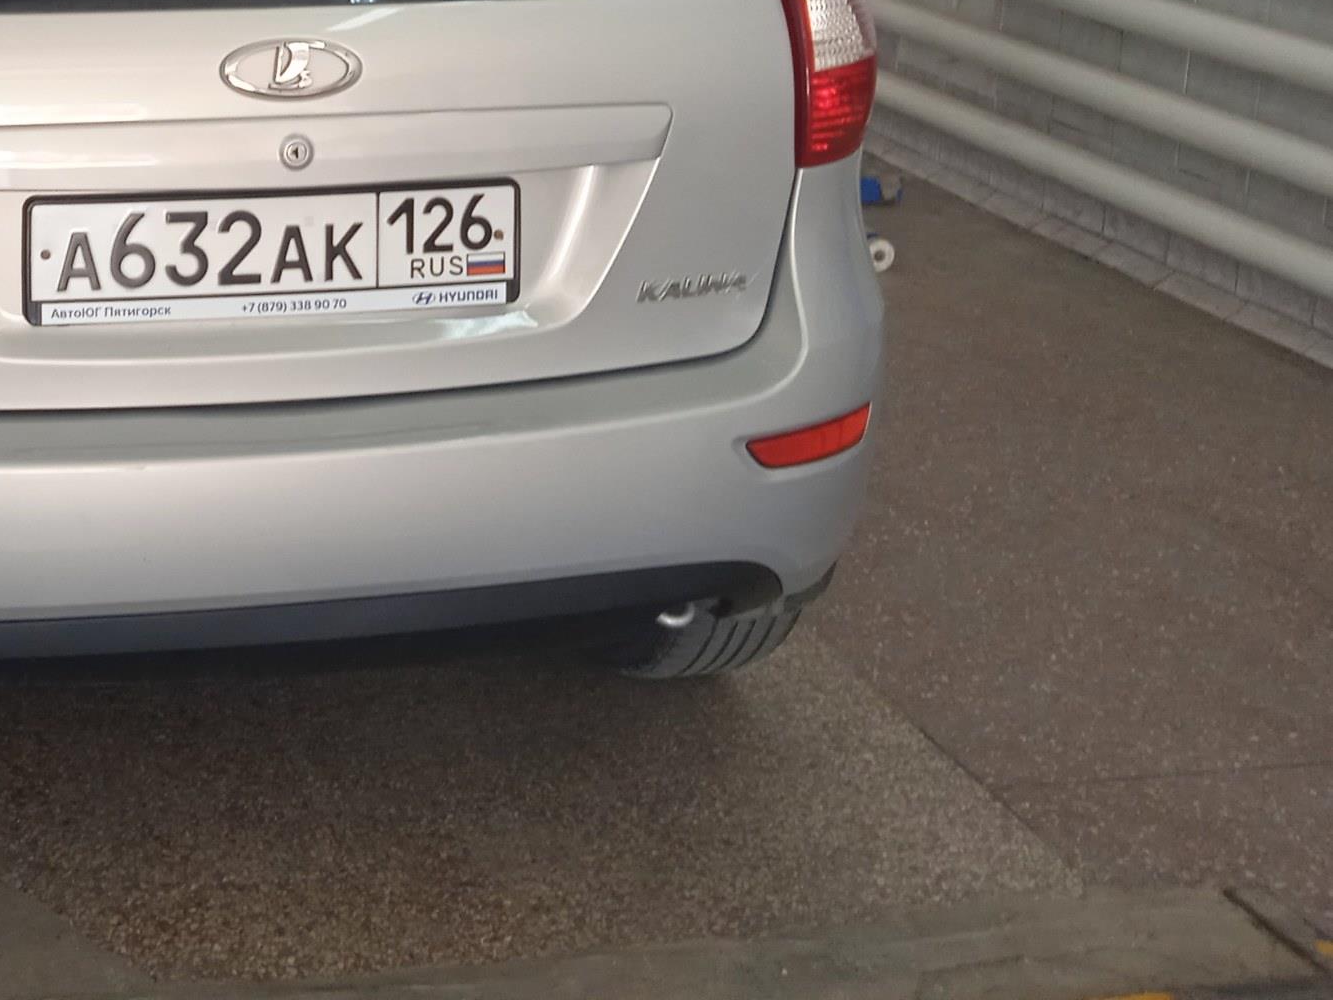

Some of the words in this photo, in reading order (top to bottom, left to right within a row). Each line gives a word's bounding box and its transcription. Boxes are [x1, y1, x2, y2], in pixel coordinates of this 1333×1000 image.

[56, 210, 364, 293] А632АК
[386, 194, 493, 255] 126
[410, 255, 465, 279] RUS
[438, 289, 498, 303] HYUNDAI
[51, 305, 102, 320] АвтоЮГ
[104, 305, 172, 319] Пятигорск
[241, 302, 255, 313] +7
[257, 301, 288, 314] (879)
[290, 300, 312, 312] 338
[314, 300, 330, 310] 90
[333, 299, 347, 309] 70
